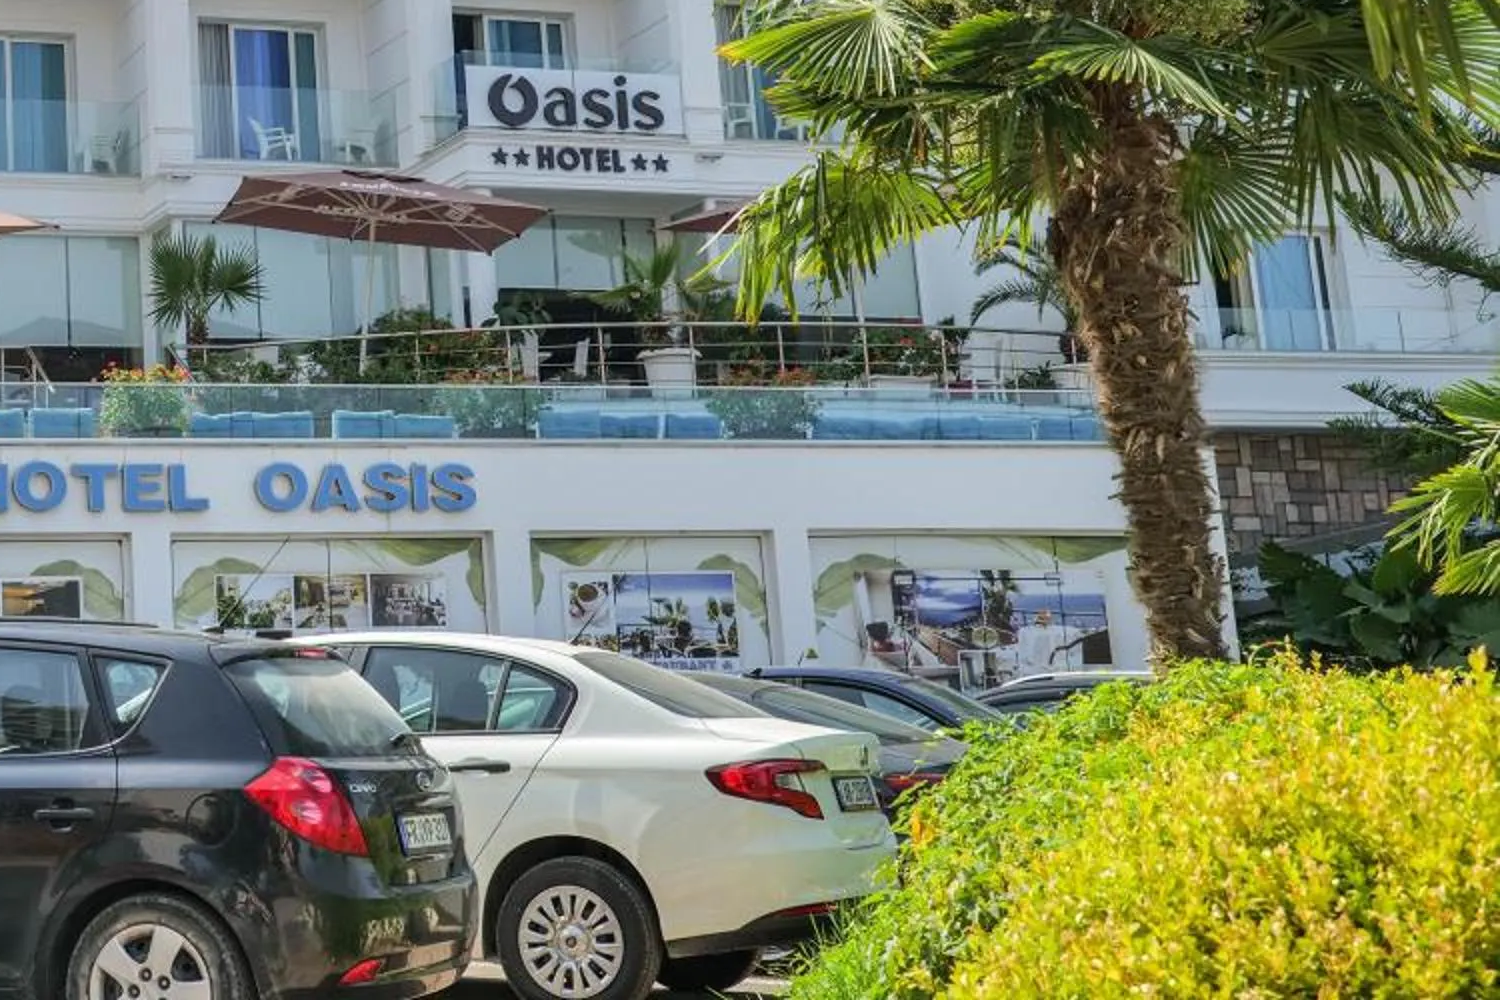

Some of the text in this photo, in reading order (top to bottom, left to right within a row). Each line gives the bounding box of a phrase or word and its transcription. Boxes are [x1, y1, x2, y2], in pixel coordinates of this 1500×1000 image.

[487, 73, 665, 131] Oasis
[536, 145, 626, 173] HOTEL
[253, 460, 478, 513] OASIS
